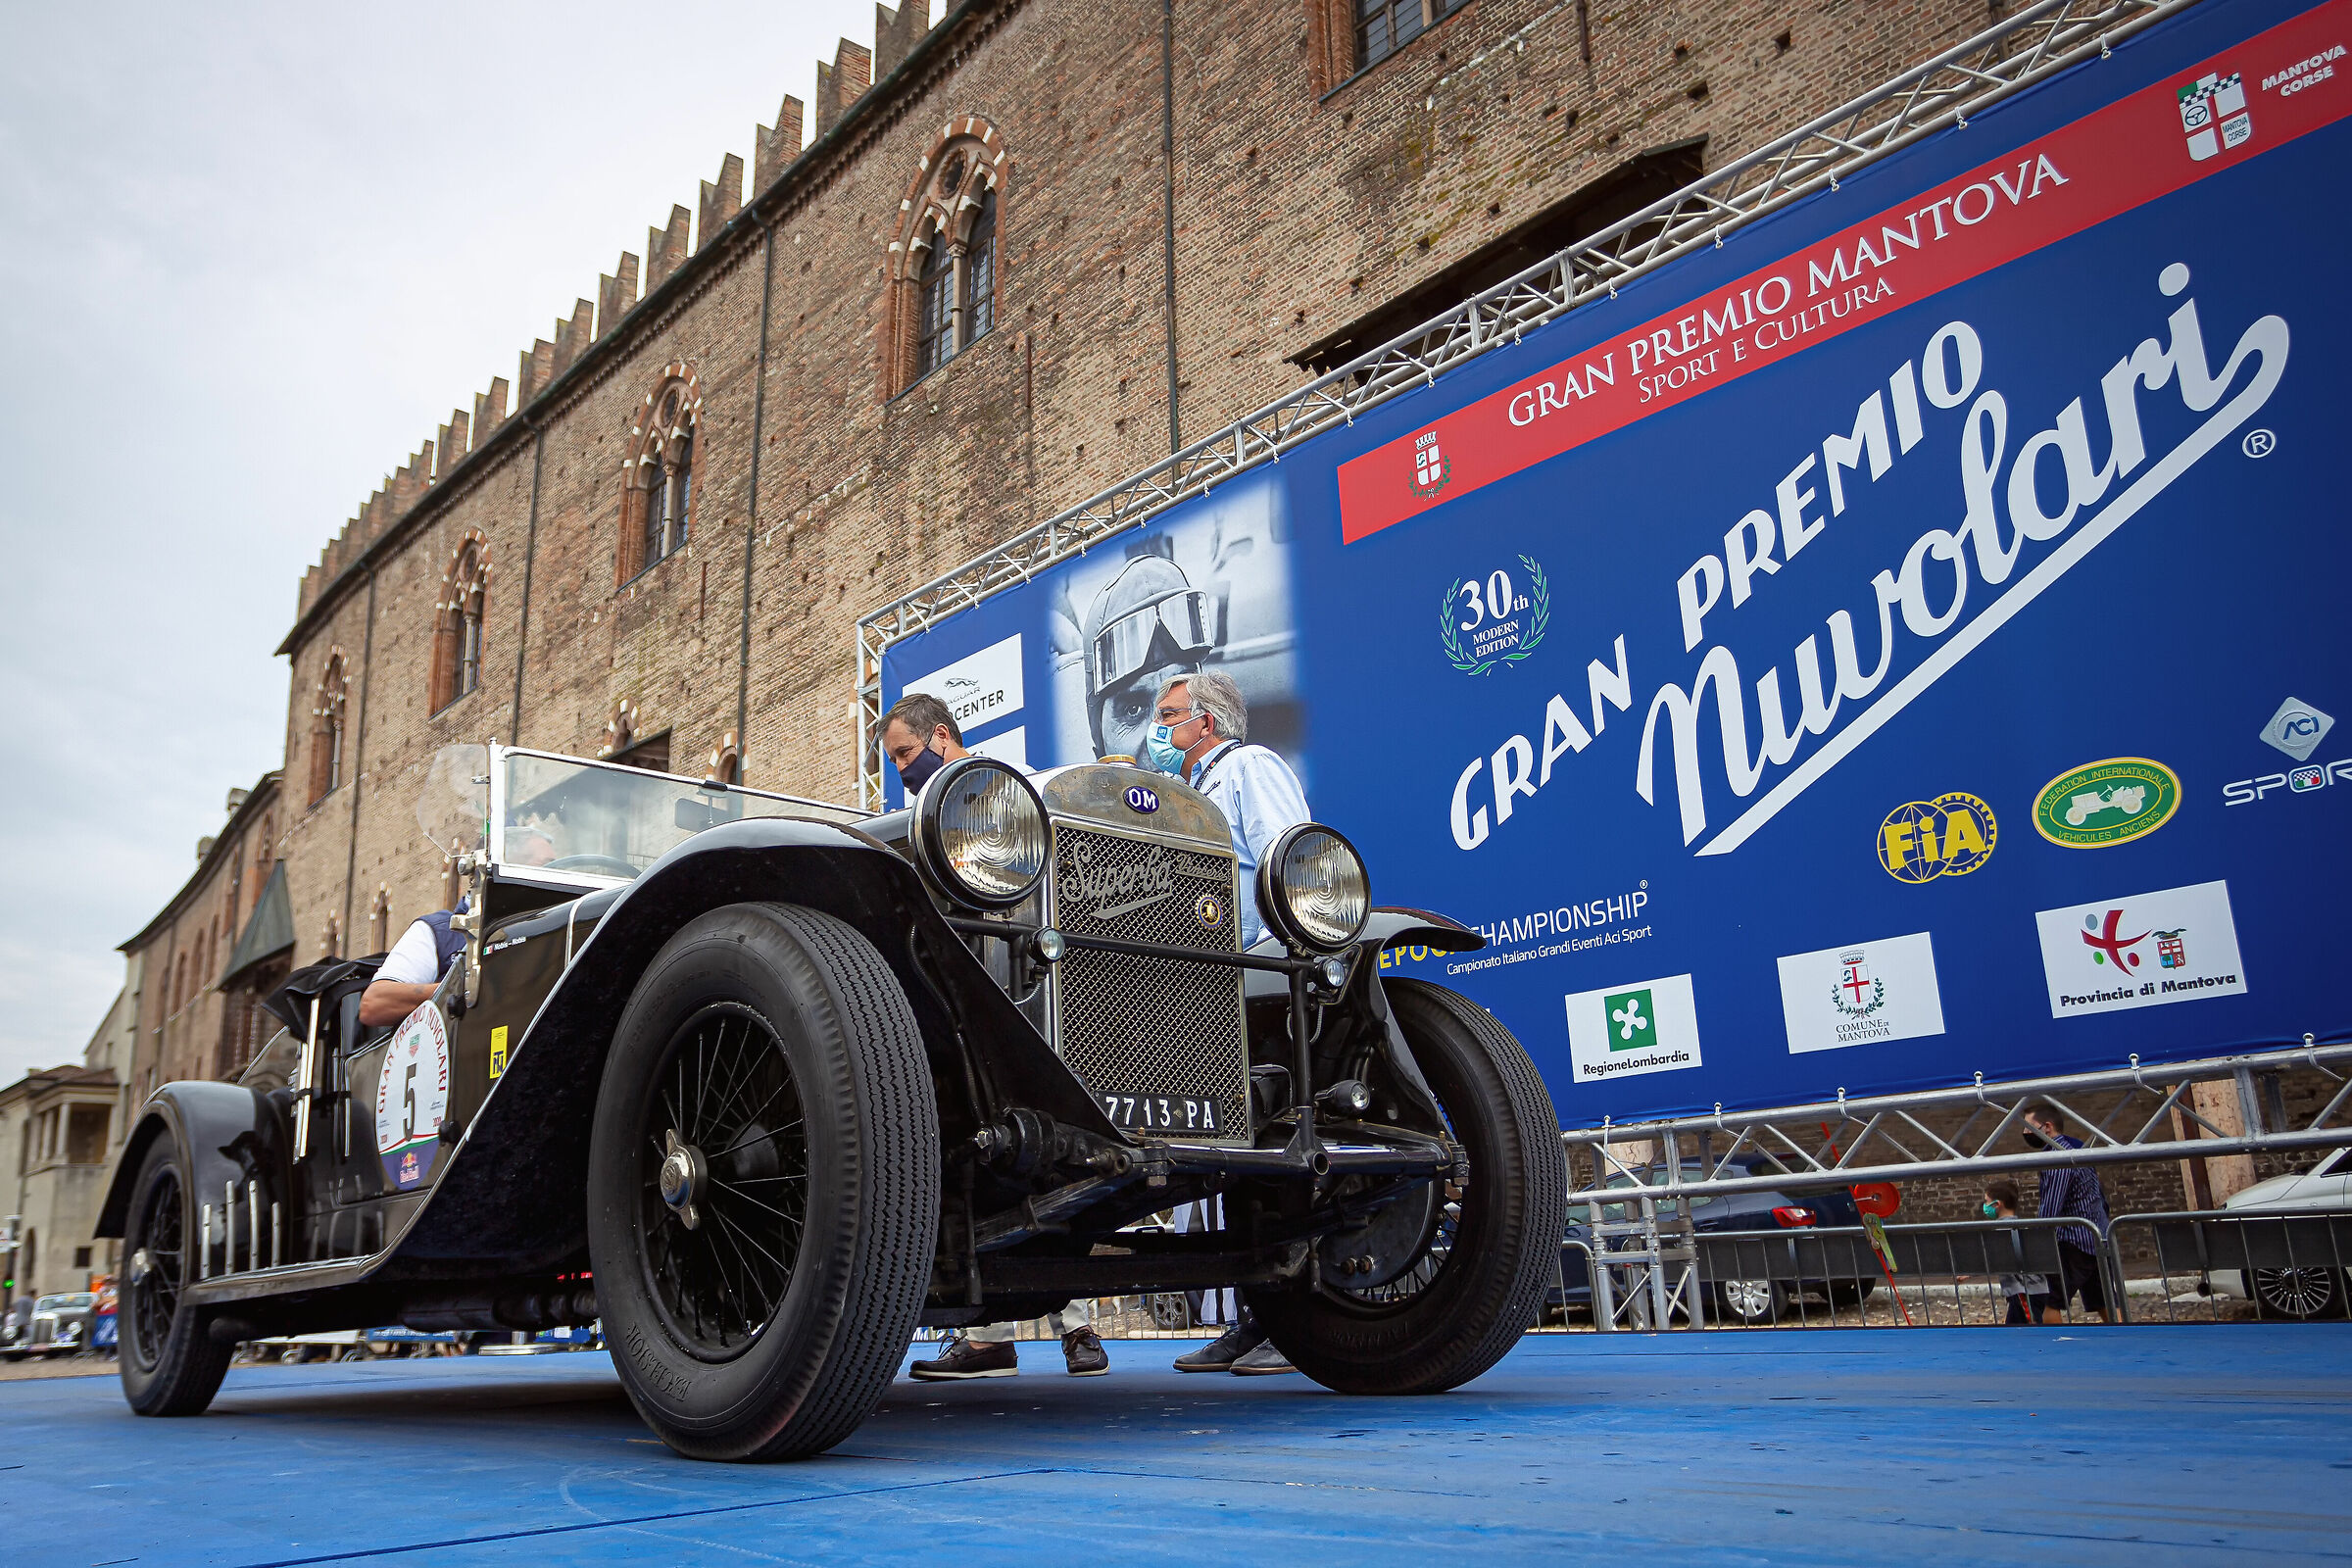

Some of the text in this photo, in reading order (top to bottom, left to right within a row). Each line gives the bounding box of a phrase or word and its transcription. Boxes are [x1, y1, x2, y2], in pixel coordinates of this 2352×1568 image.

[2261, 44, 2347, 91] MANTOVA
[2279, 65, 2334, 97] CORSE
[1507, 153, 2070, 427] GRAN PREMIO MANTOVA
[1638, 348, 1721, 404] SPORT
[1753, 277, 1895, 351] CULTURA
[1636, 262, 2290, 858] Nuvolari
[1449, 319, 1984, 851] GRAN PREMIO
[1459, 568, 1530, 632] 30th
[1472, 618, 1520, 646] MODERN
[1475, 632, 1520, 659] EDITION
[947, 686, 981, 705] AGUAR
[950, 689, 1004, 721] CENTER
[1128, 788, 1158, 810] OM
[2038, 766, 2171, 816] FEDERATION INTERNATIONALE
[2058, 809, 2161, 843] VEHICULES ANCIENS
[1061, 841, 1174, 920] Superba
[1379, 945, 1455, 969] EPO
[1446, 924, 1653, 976] Campionato Italiano Grandi Eventi Aci Sport
[2060, 972, 2237, 1007] Provincia di Mantova
[1836, 1018, 1884, 1034] COMUNE
[1838, 1027, 1890, 1043] MANTOVA
[425, 1006, 447, 1092] NUVOLARI
[1583, 1050, 1690, 1077] RegioneLombardia
[403, 1062, 417, 1143] 5
[1105, 1096, 1215, 1129] 7713 PA
